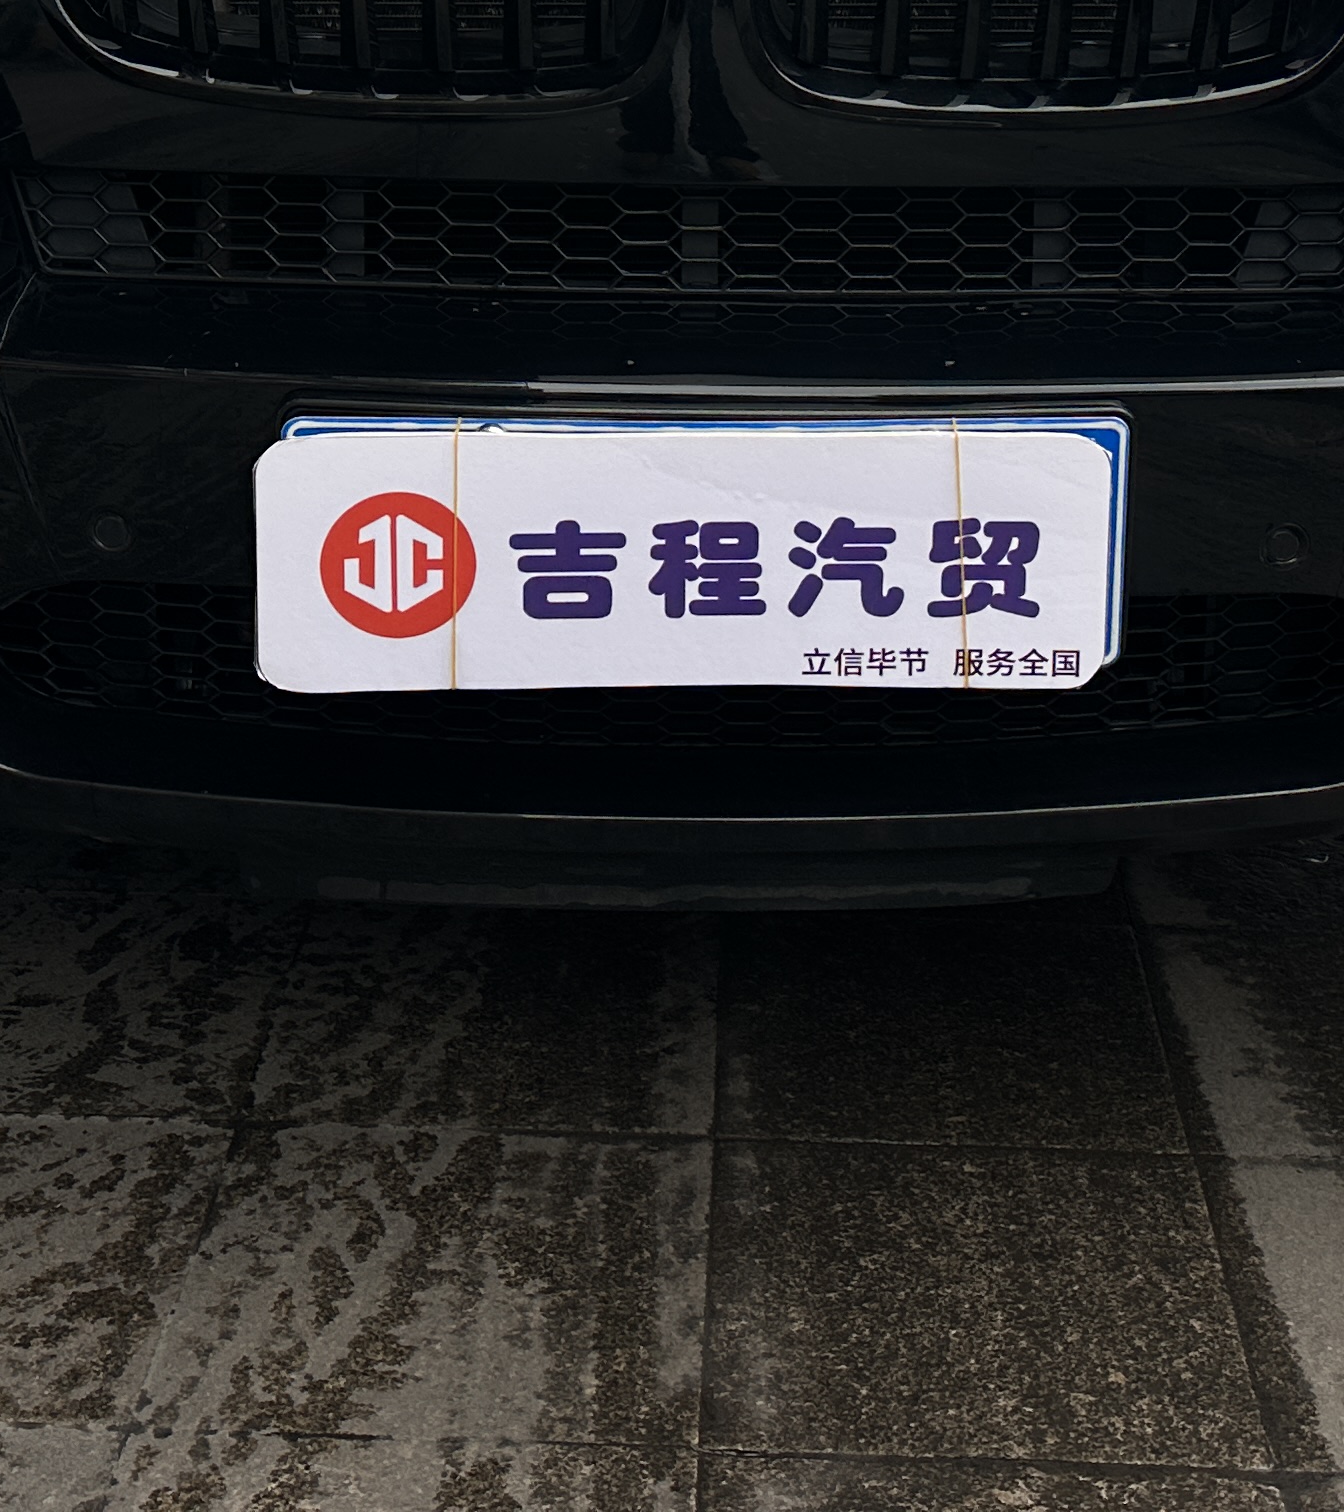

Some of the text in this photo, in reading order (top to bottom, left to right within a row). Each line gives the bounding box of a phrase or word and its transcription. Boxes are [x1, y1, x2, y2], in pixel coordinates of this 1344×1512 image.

[343, 514, 444, 613] JC
[508, 517, 1041, 620] 吉程汽贸
[802, 647, 1081, 678] 立信毕节 服务全国
